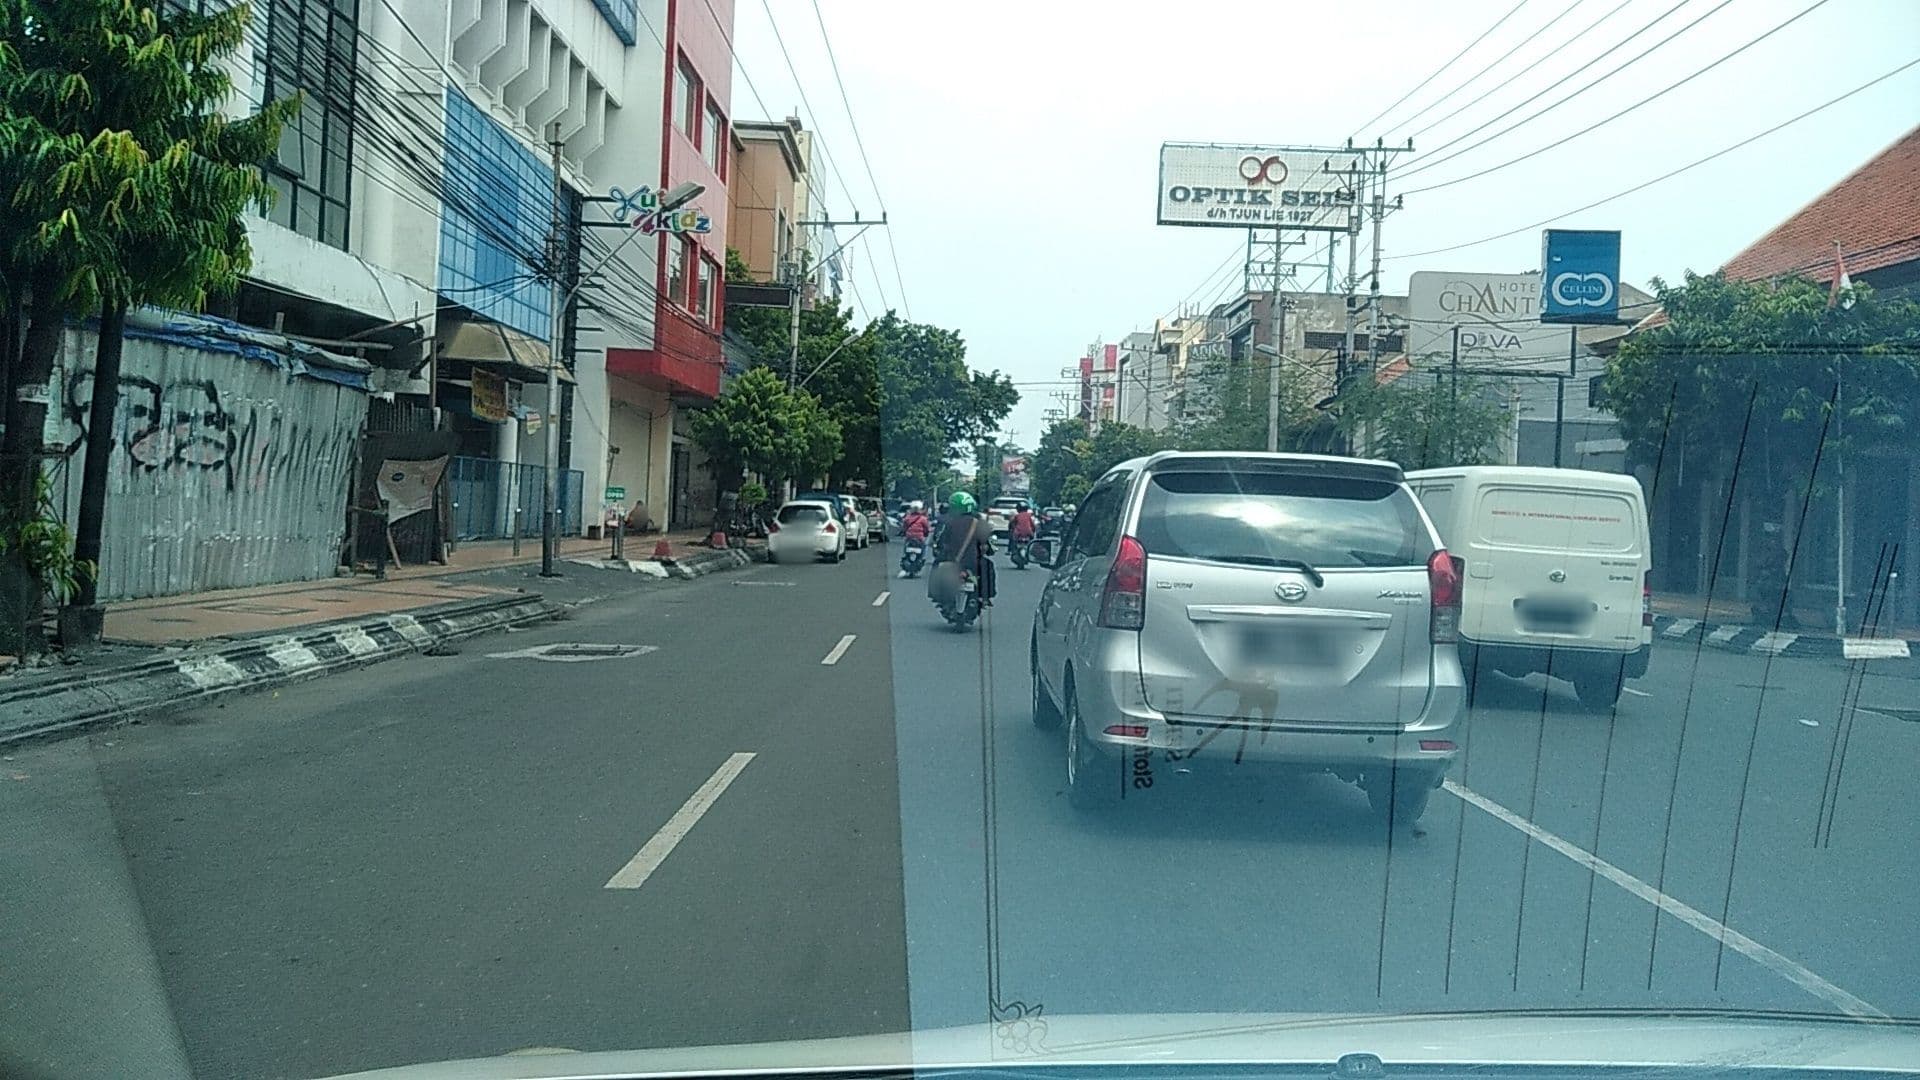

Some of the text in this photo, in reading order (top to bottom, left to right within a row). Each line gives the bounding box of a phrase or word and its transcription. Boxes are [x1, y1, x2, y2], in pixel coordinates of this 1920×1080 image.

[1169, 186, 1272, 206] OPTIK
[1207, 208, 1314, 222] d/h TJUN LIE 1927
[1499, 282, 1536, 293] HOTE
[1561, 284, 1603, 294] CELLINI
[1439, 282, 1536, 314] CHANT
